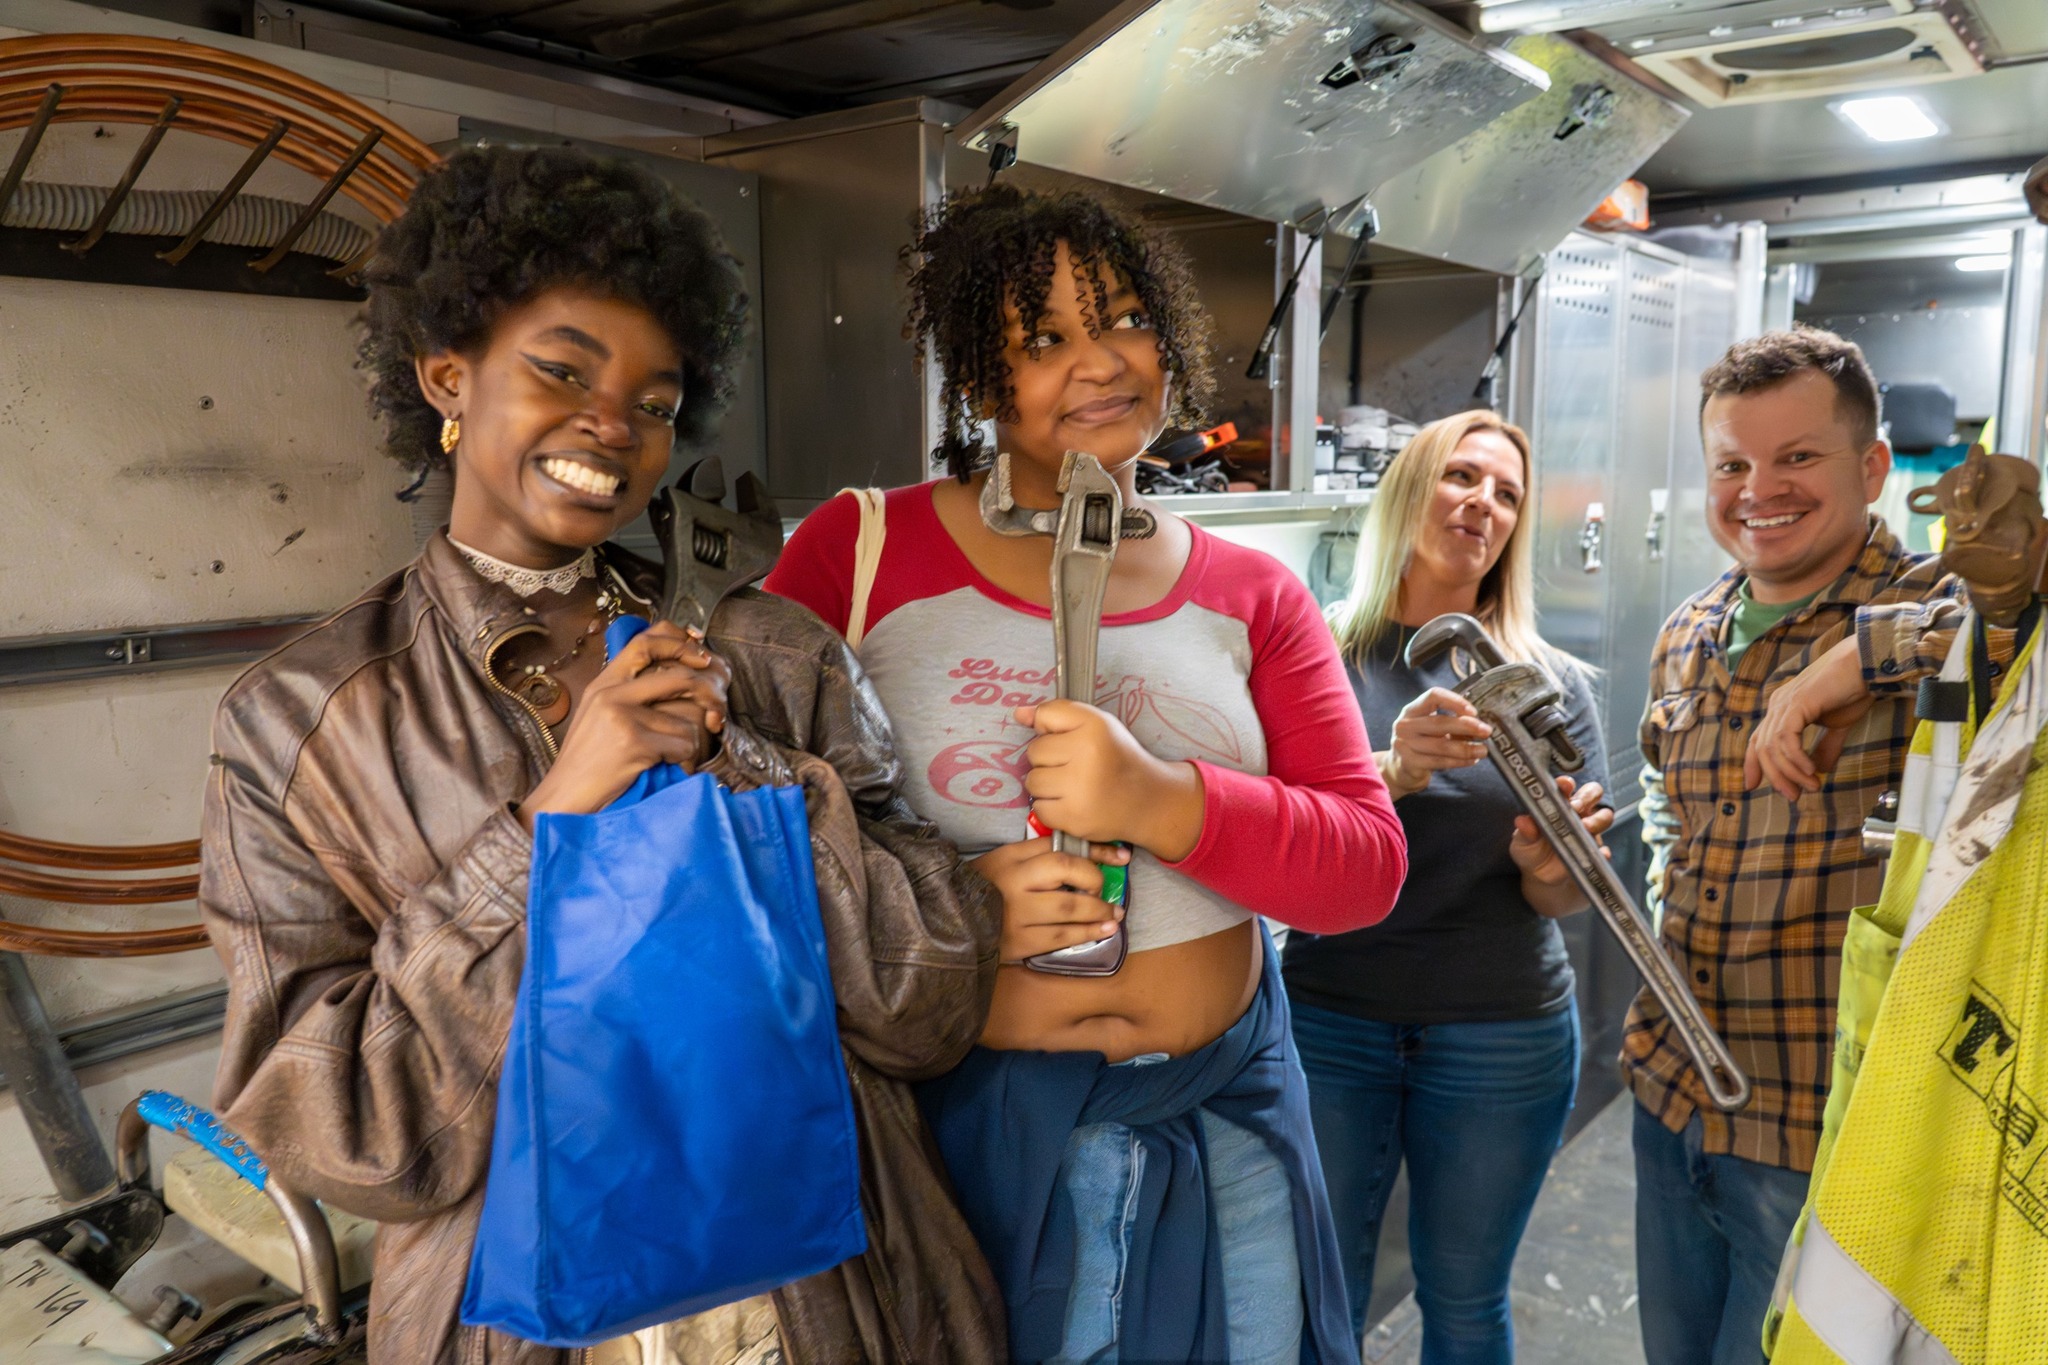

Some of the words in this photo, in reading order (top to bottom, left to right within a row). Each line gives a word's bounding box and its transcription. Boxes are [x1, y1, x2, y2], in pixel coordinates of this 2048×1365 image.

[951, 682, 1049, 707] Da
[971, 777, 1003, 796] 8
[1953, 994, 2015, 1074] T
[33, 1283, 90, 1328] 169
